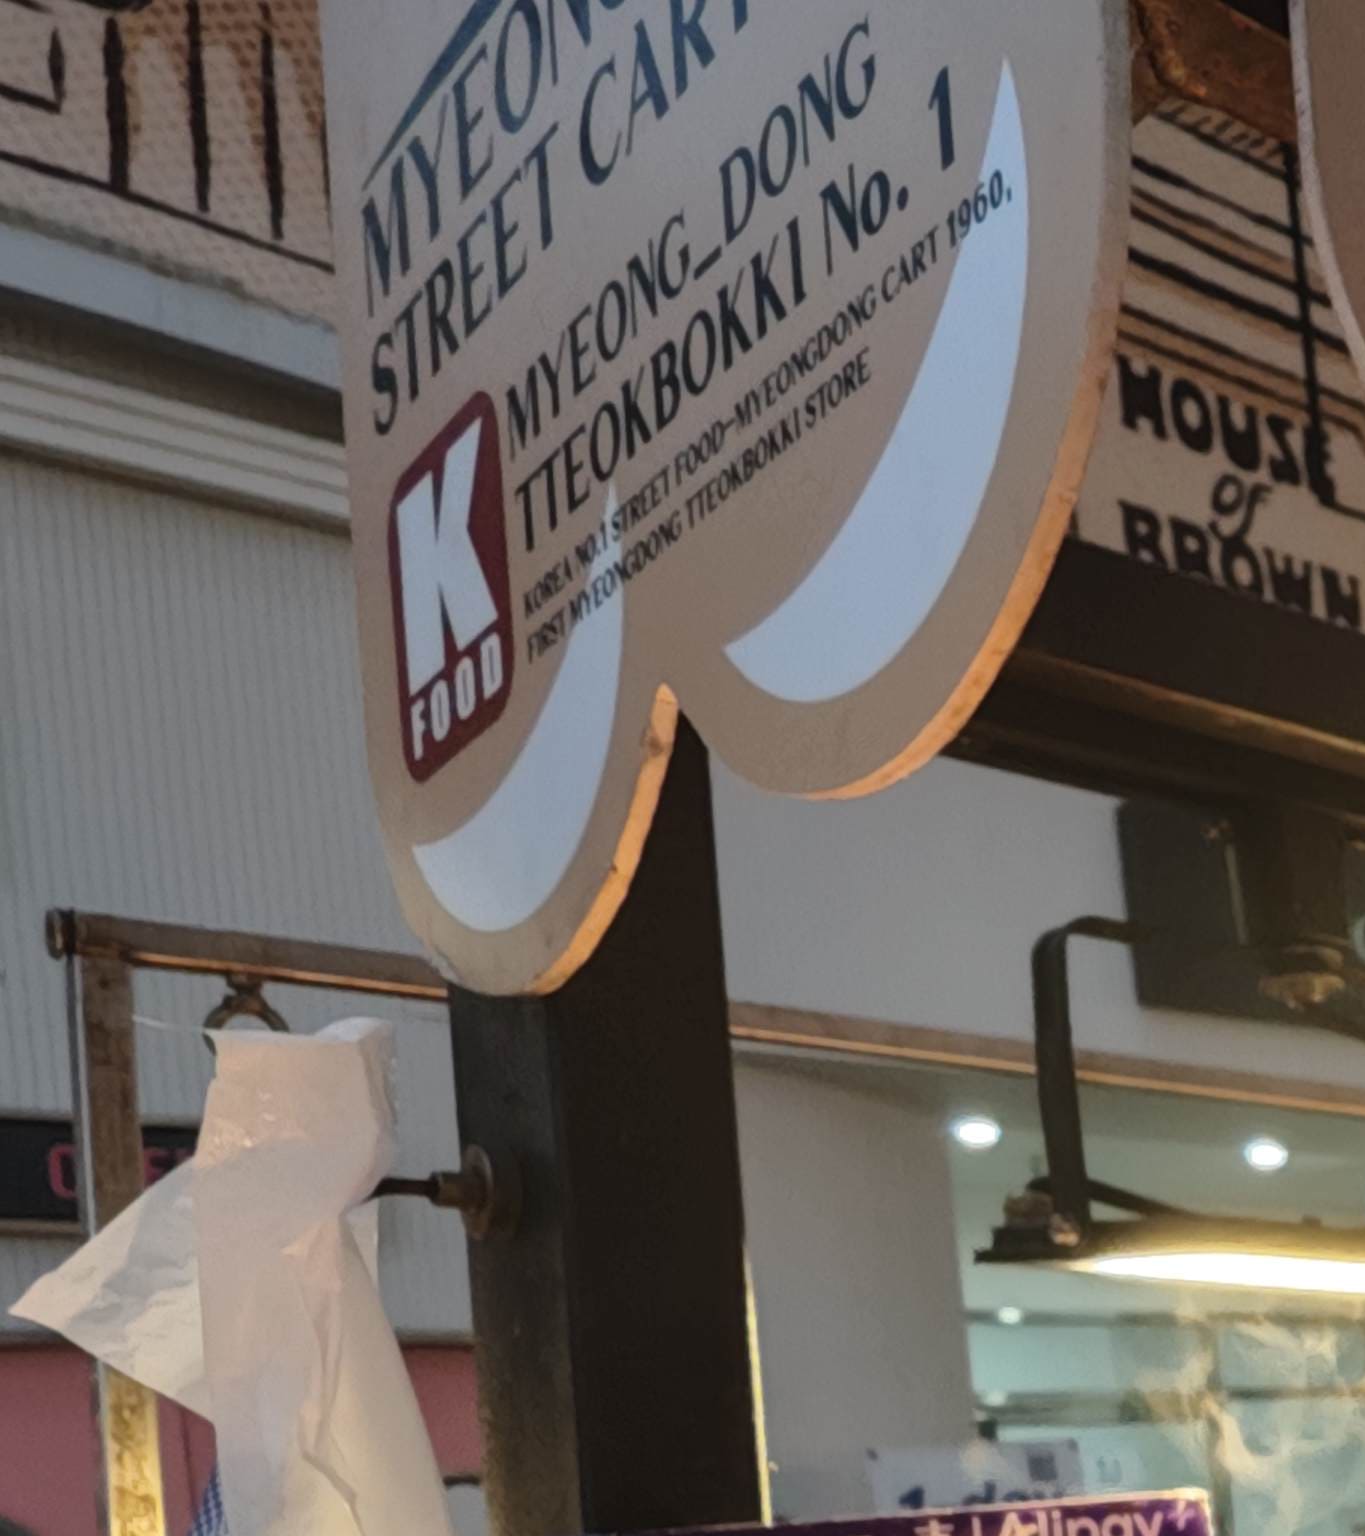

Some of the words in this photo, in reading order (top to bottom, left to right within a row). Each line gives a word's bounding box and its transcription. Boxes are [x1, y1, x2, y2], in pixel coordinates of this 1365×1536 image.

[362, 0, 622, 317] MYEON
[371, 121, 559, 435] STREET
[579, 0, 749, 186] CAR
[514, 216, 807, 553] TTEOKBOKKI
[819, 163, 909, 276] No.
[928, 65, 955, 171] 1
[396, 416, 498, 701] K
[524, 557, 573, 619] KOREA
[610, 465, 670, 541] STREET
[880, 224, 940, 306] CART
[526, 611, 570, 664] FIRST
[569, 513, 682, 622] MYEONGDONG
[685, 414, 801, 521] TTEOKBOKKI
[804, 346, 874, 429] STORE
[1115, 352, 1336, 505] HOUSE
[1117, 498, 1362, 628] BROWN
[409, 632, 504, 762] FOOD
